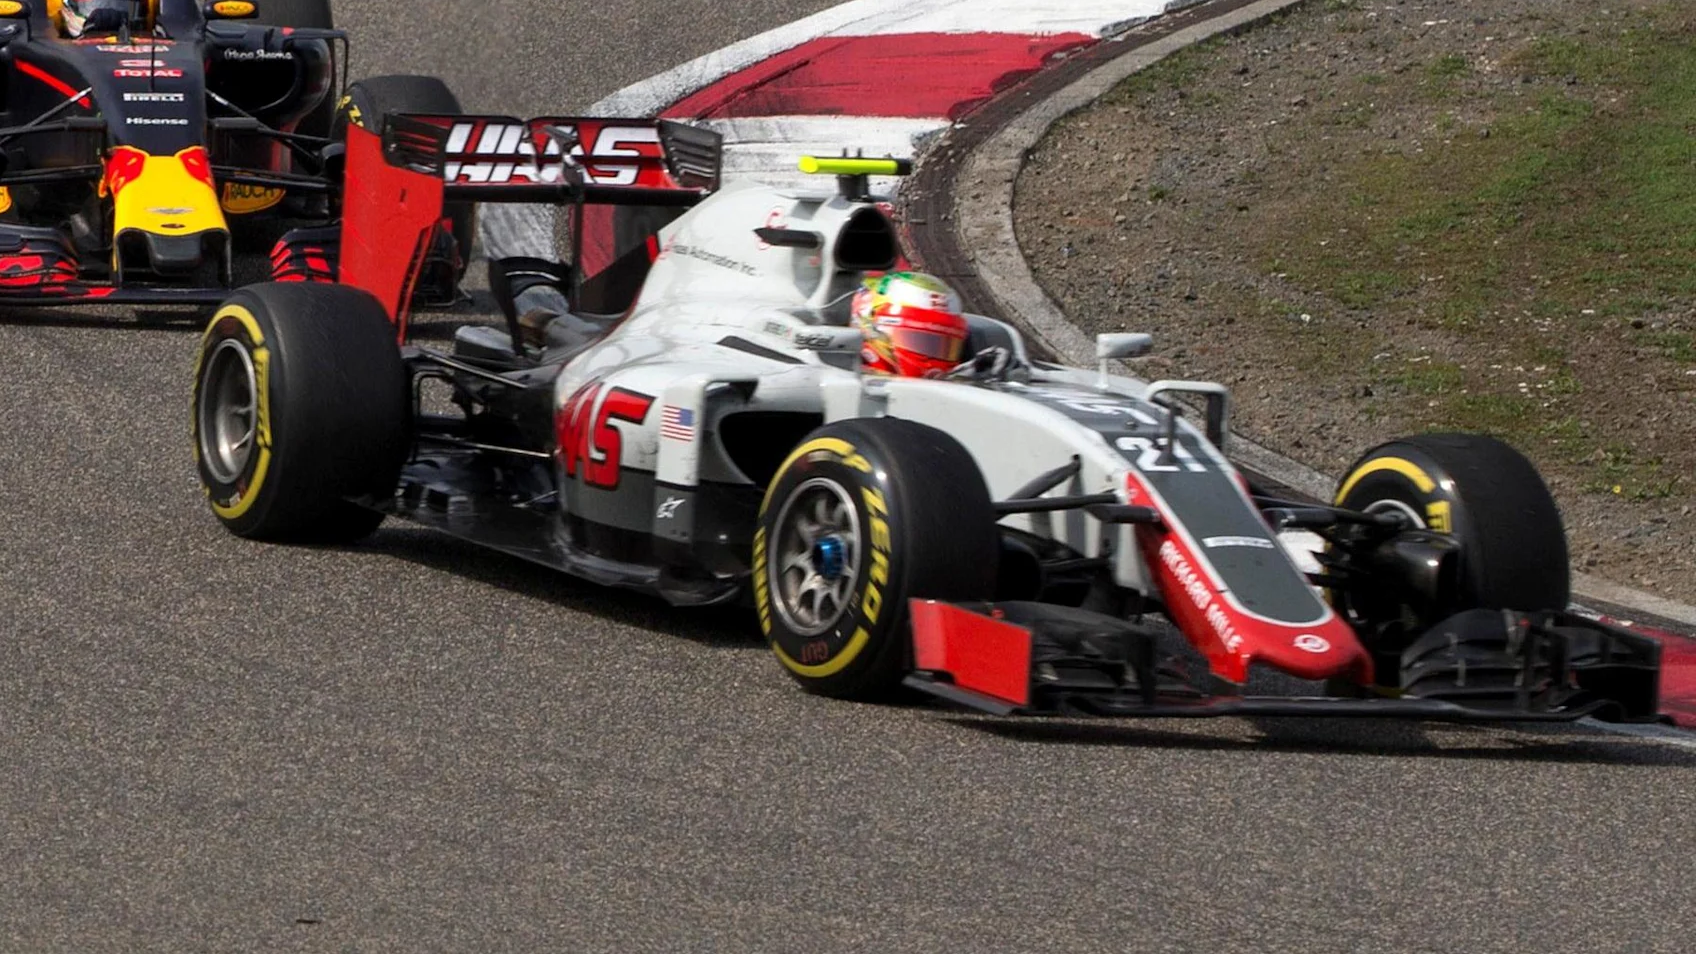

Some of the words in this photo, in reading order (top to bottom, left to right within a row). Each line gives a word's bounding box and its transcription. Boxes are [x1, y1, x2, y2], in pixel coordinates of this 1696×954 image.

[117, 69, 182, 77] TOTAL
[123, 93, 184, 101] PIRELLI
[126, 117, 189, 125] Hisense
[445, 122, 660, 186] HAAS
[1115, 437, 1208, 472] 21
[860, 486, 892, 625] ZERO
[1205, 603, 1244, 654] MILLE
